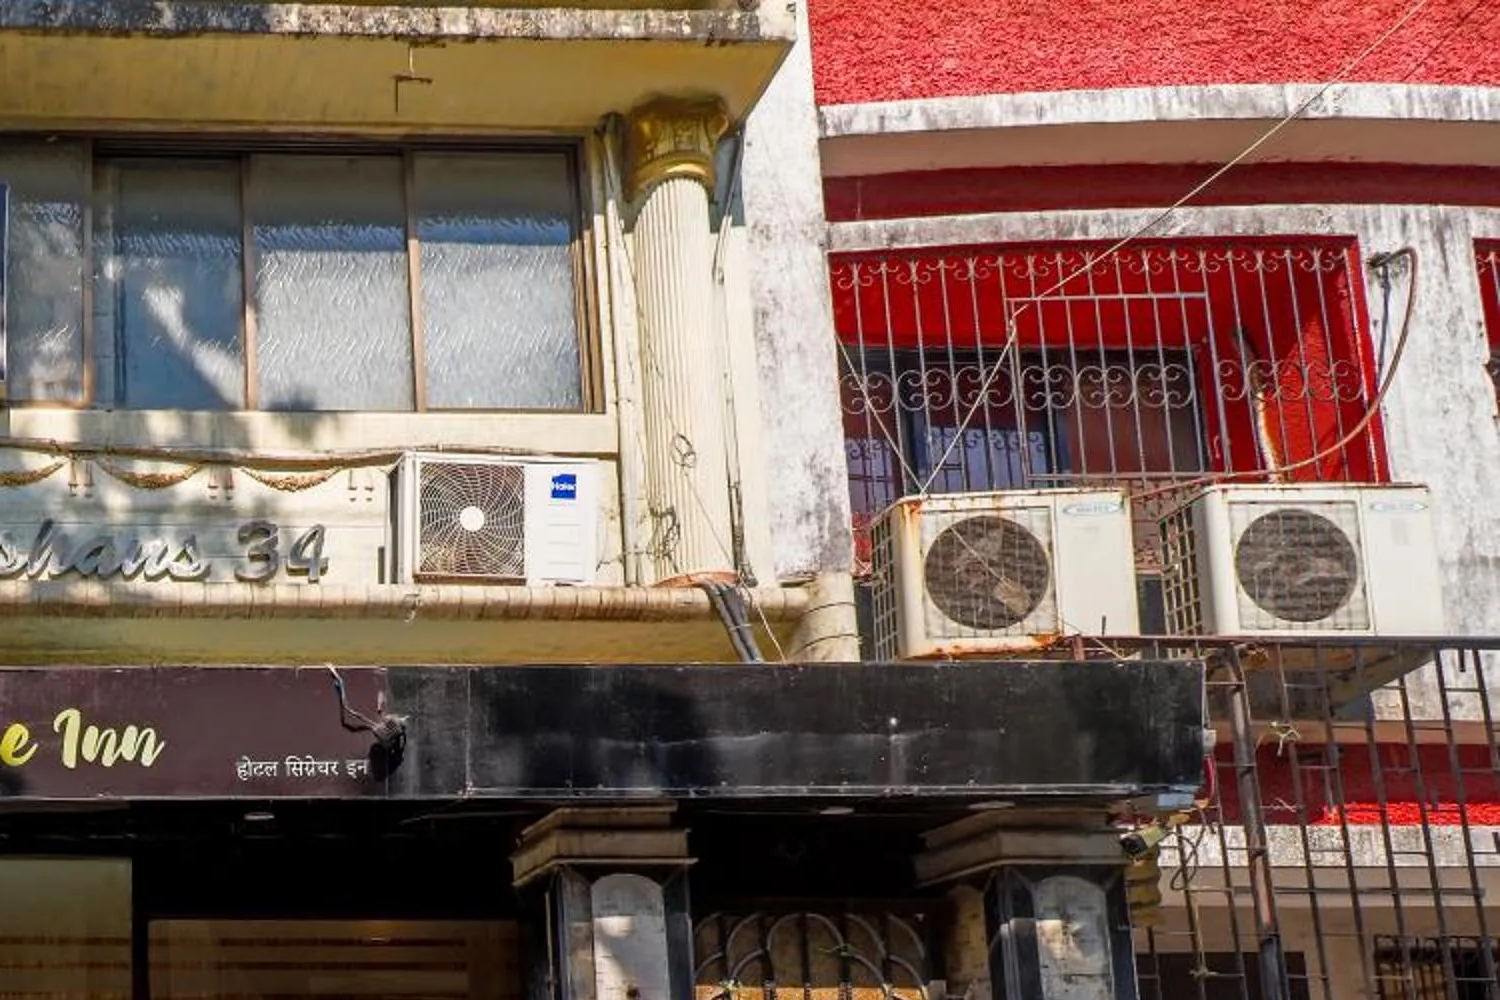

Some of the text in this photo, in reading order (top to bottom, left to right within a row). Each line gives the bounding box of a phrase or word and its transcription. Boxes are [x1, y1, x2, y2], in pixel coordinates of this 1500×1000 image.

[233, 520, 330, 584] 34
[52, 707, 165, 769] Inn
[236, 755, 279, 781] होटल
[345, 759, 369, 779] इन
